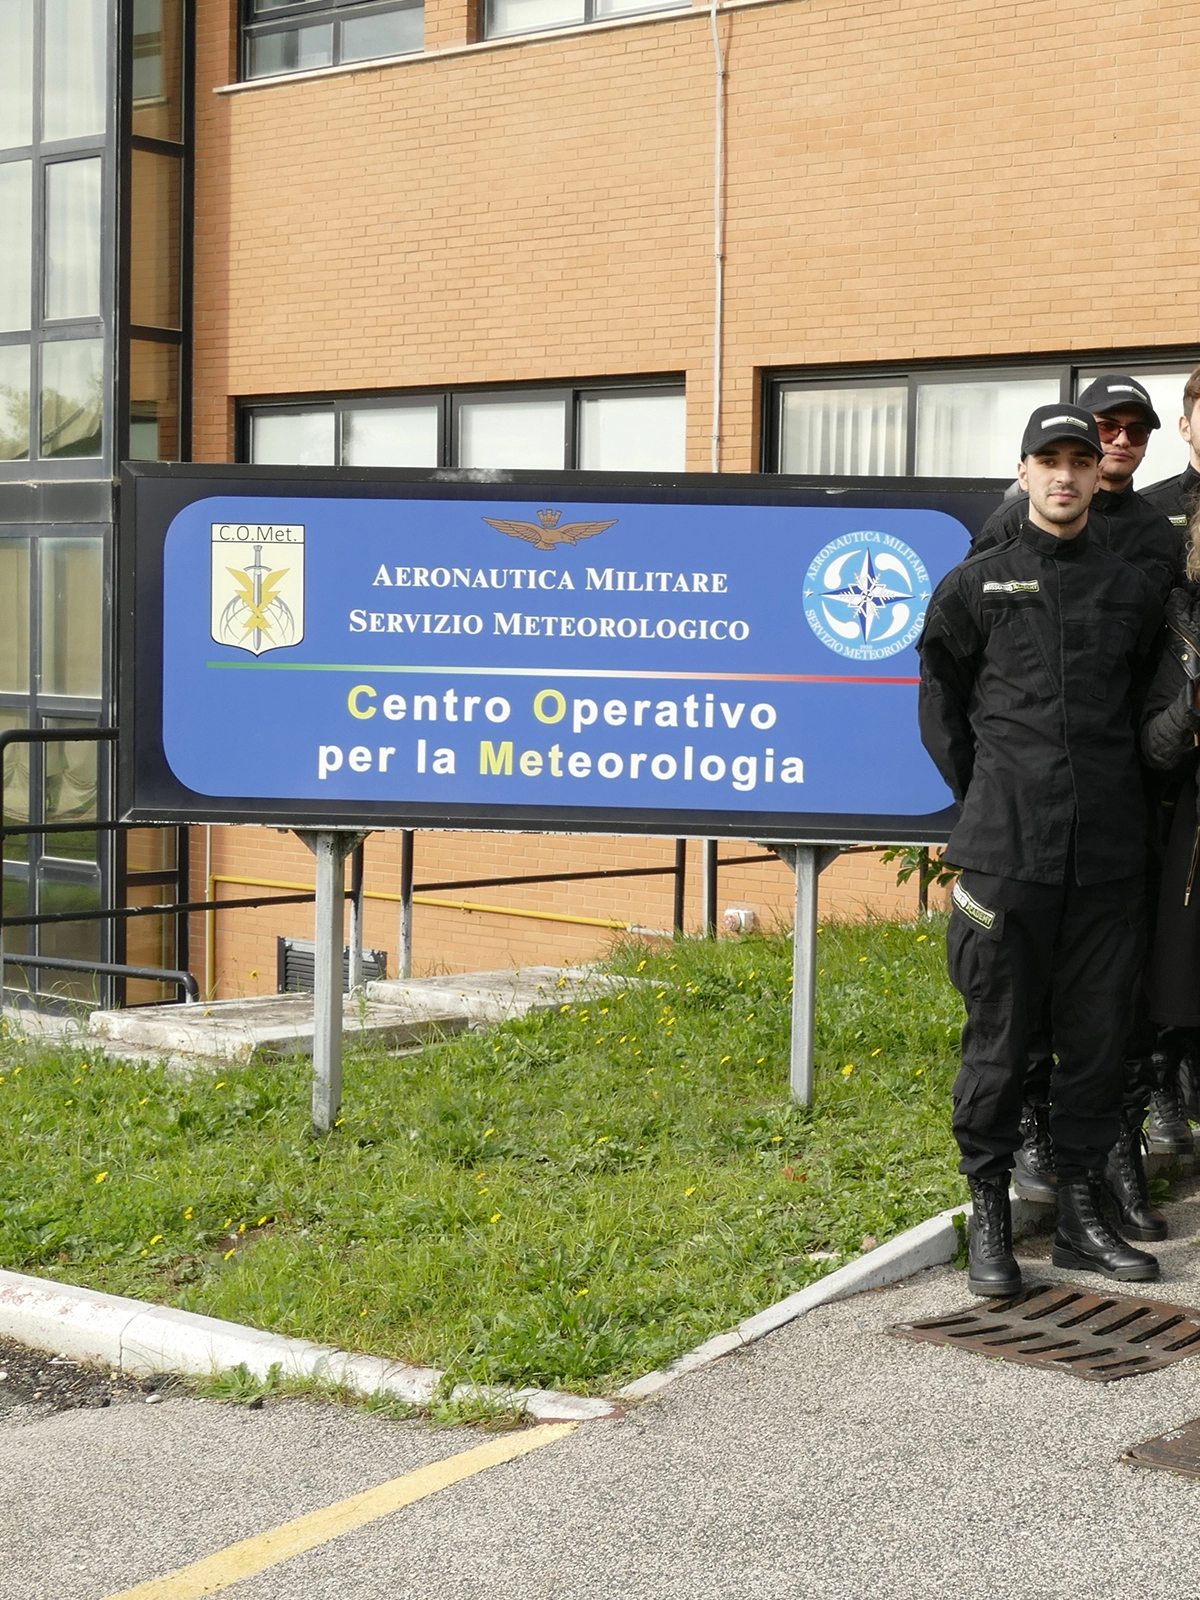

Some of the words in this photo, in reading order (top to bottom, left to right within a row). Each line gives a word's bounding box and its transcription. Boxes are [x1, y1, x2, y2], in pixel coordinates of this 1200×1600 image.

[220, 526, 297, 542] C.O.Met.
[807, 532, 881, 581] AERONAUTICA
[883, 535, 928, 583] MILITARE
[372, 563, 576, 590] AERONAUTICA
[585, 567, 728, 593] MILITARE
[349, 609, 484, 635] SERVIZIO
[492, 612, 750, 641] METEOROLOGICO
[806, 609, 843, 653] SERVIZIO
[843, 612, 926, 660] METEOROLOGICO
[347, 684, 511, 723] Centro
[533, 688, 777, 733] Operativo
[318, 745, 396, 780] per
[416, 739, 456, 775] la
[479, 740, 805, 792] Meteorologia
[965, 902, 993, 925] ACADEMY
